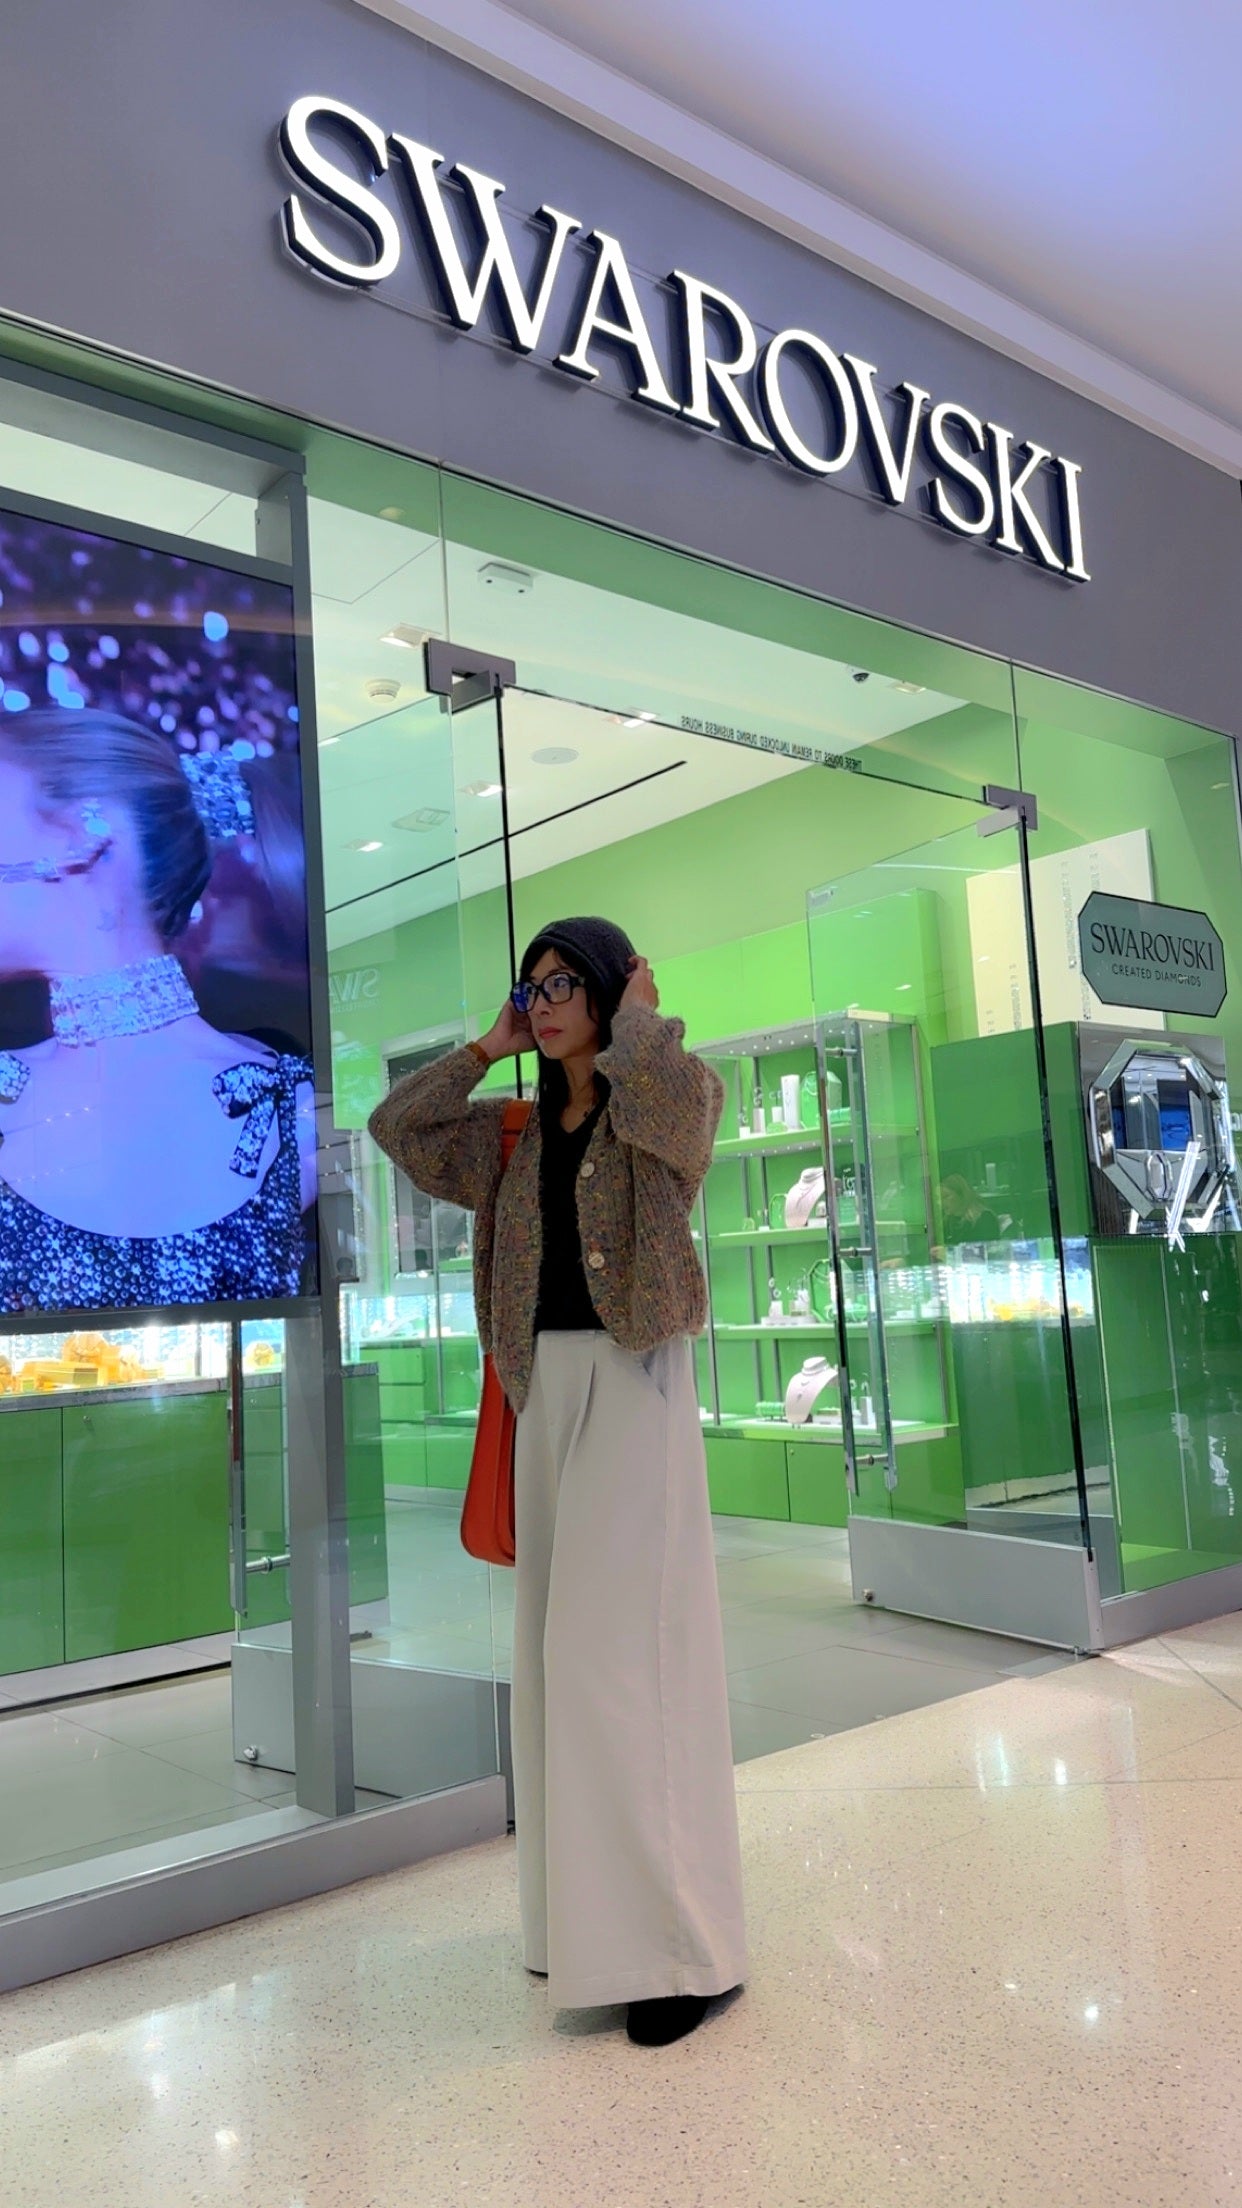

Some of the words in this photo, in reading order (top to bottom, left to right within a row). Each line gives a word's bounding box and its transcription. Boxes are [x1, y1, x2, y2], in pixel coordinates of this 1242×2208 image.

[280, 95, 1091, 583] SWAROVSKI
[1090, 922, 1215, 971] SWAROVSKI
[1112, 963, 1151, 980] CREATED
[1155, 970, 1202, 987] DIAMONDS
